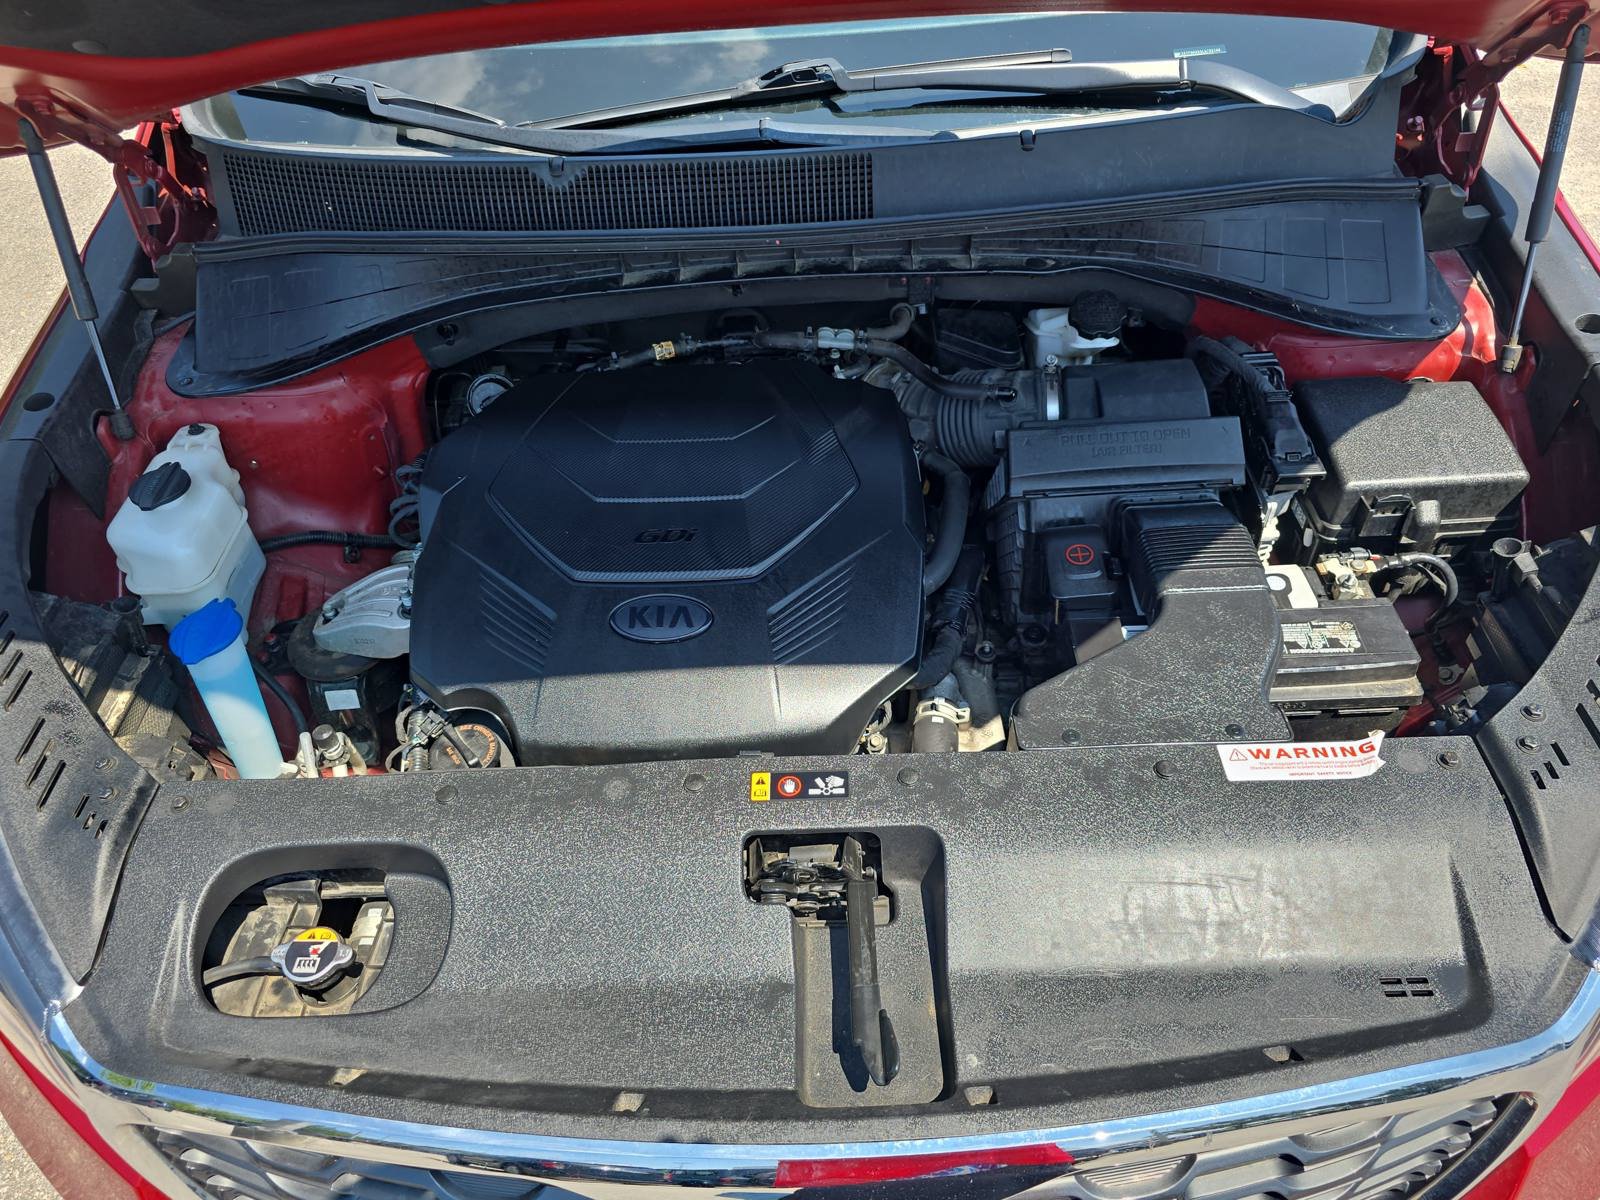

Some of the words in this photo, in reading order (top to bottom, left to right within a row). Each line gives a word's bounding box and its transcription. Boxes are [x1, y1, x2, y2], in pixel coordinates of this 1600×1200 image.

[1061, 433, 1096, 446] PULL
[1099, 431, 1128, 444] OUT
[1130, 430, 1149, 443] TO
[1153, 427, 1191, 441] OPEN
[635, 528, 698, 543] GDi
[628, 605, 695, 629] KIA
[1247, 741, 1376, 760] WARNING
